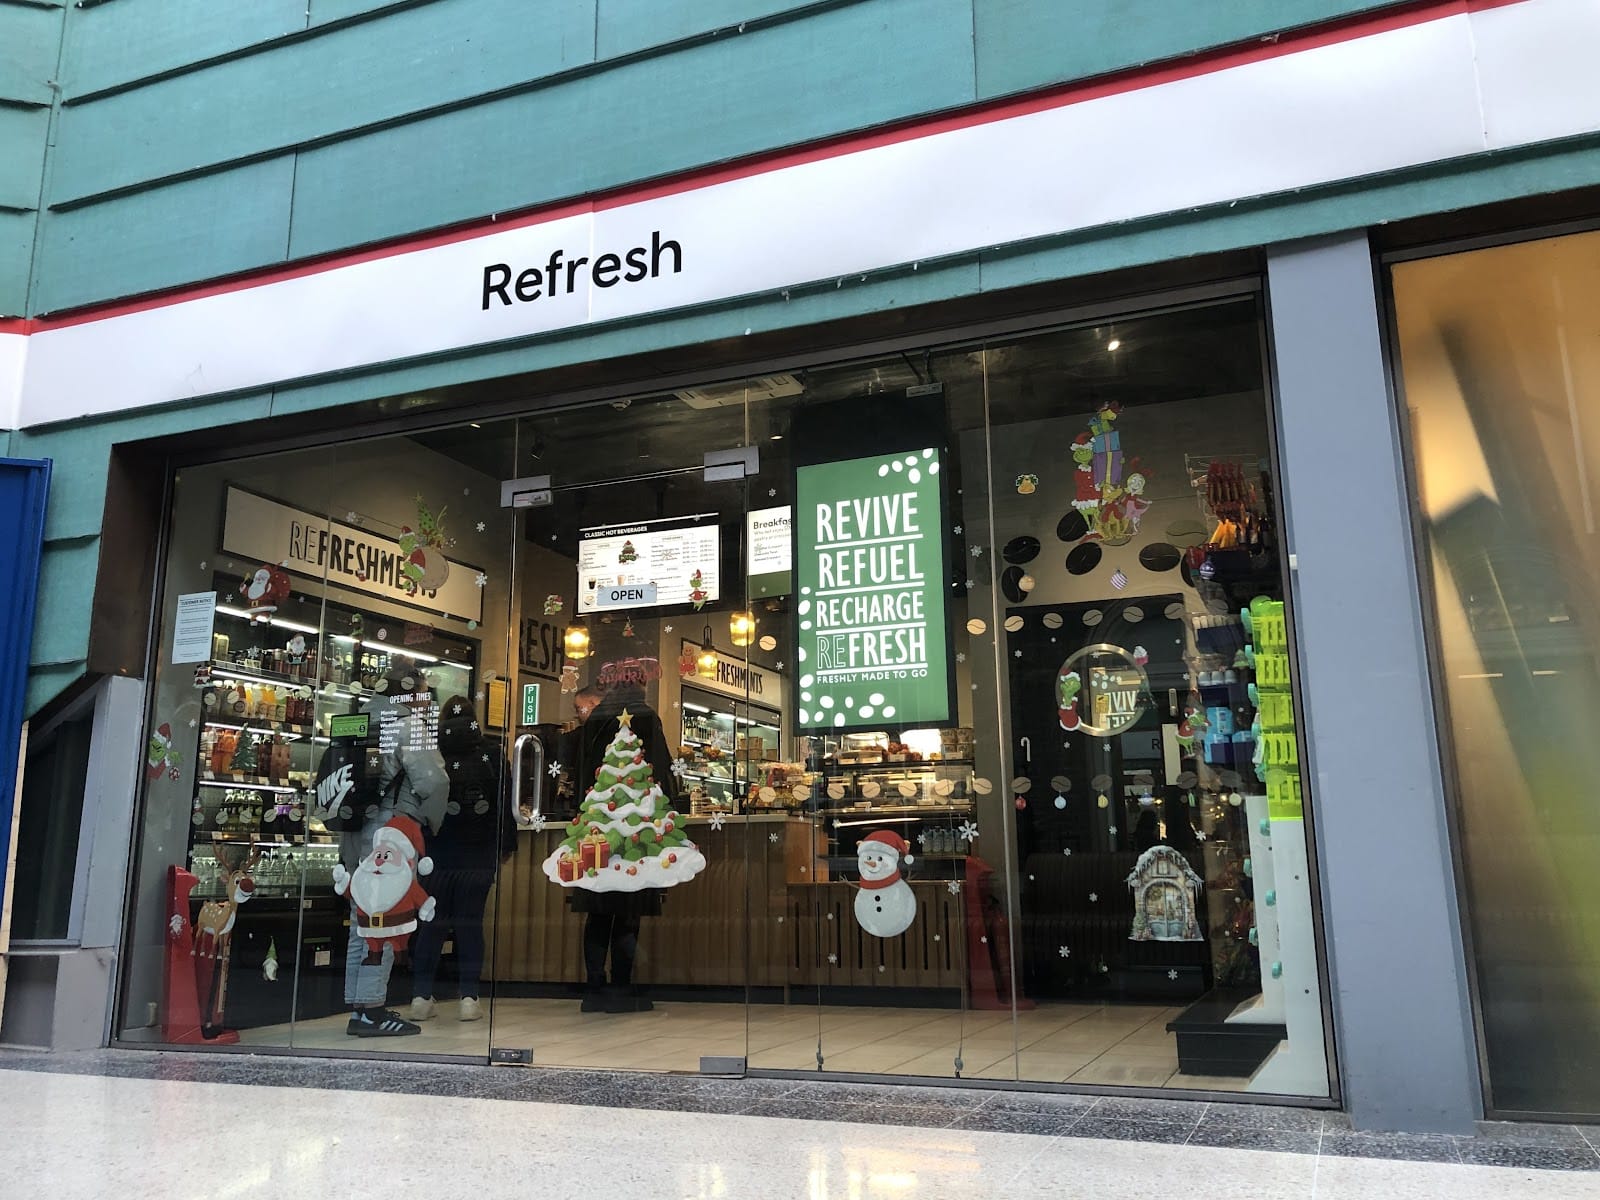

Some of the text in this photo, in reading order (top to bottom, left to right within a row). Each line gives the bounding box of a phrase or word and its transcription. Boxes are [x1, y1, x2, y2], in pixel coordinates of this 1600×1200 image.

[482, 230, 682, 311] Refresh
[584, 530, 605, 538] CLASSIC
[617, 525, 648, 534] BEVERAGES
[816, 492, 919, 543] REVIVE
[818, 543, 924, 589] REFUEL
[611, 589, 643, 601] OPEN
[816, 591, 925, 628] RECHARGE
[816, 628, 927, 670] REFRESH
[817, 668, 928, 685] FRESHLY MADE TO GO
[390, 692, 432, 704] OPENING TIMES
[526, 686, 534, 723] PUSH
[317, 763, 354, 808] NIKE
